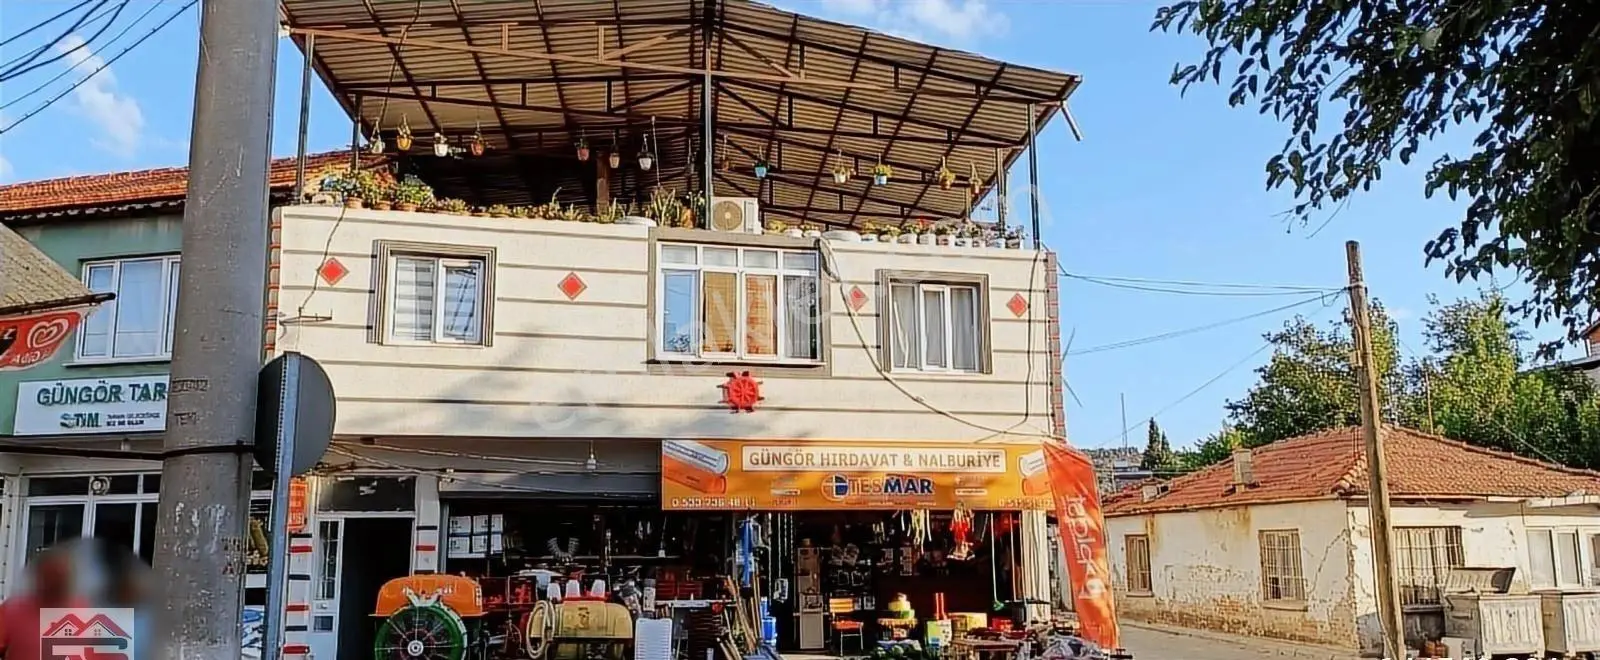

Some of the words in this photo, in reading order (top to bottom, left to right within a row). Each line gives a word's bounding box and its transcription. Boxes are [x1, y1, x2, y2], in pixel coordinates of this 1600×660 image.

[36, 380, 122, 406] GÜNGÖR
[749, 448, 816, 466] GÜNGÖR
[820, 452, 899, 467] HIRDAVAT
[903, 452, 914, 466] &
[918, 451, 1001, 468] NALBURİYE
[849, 475, 934, 495] TESMAR
